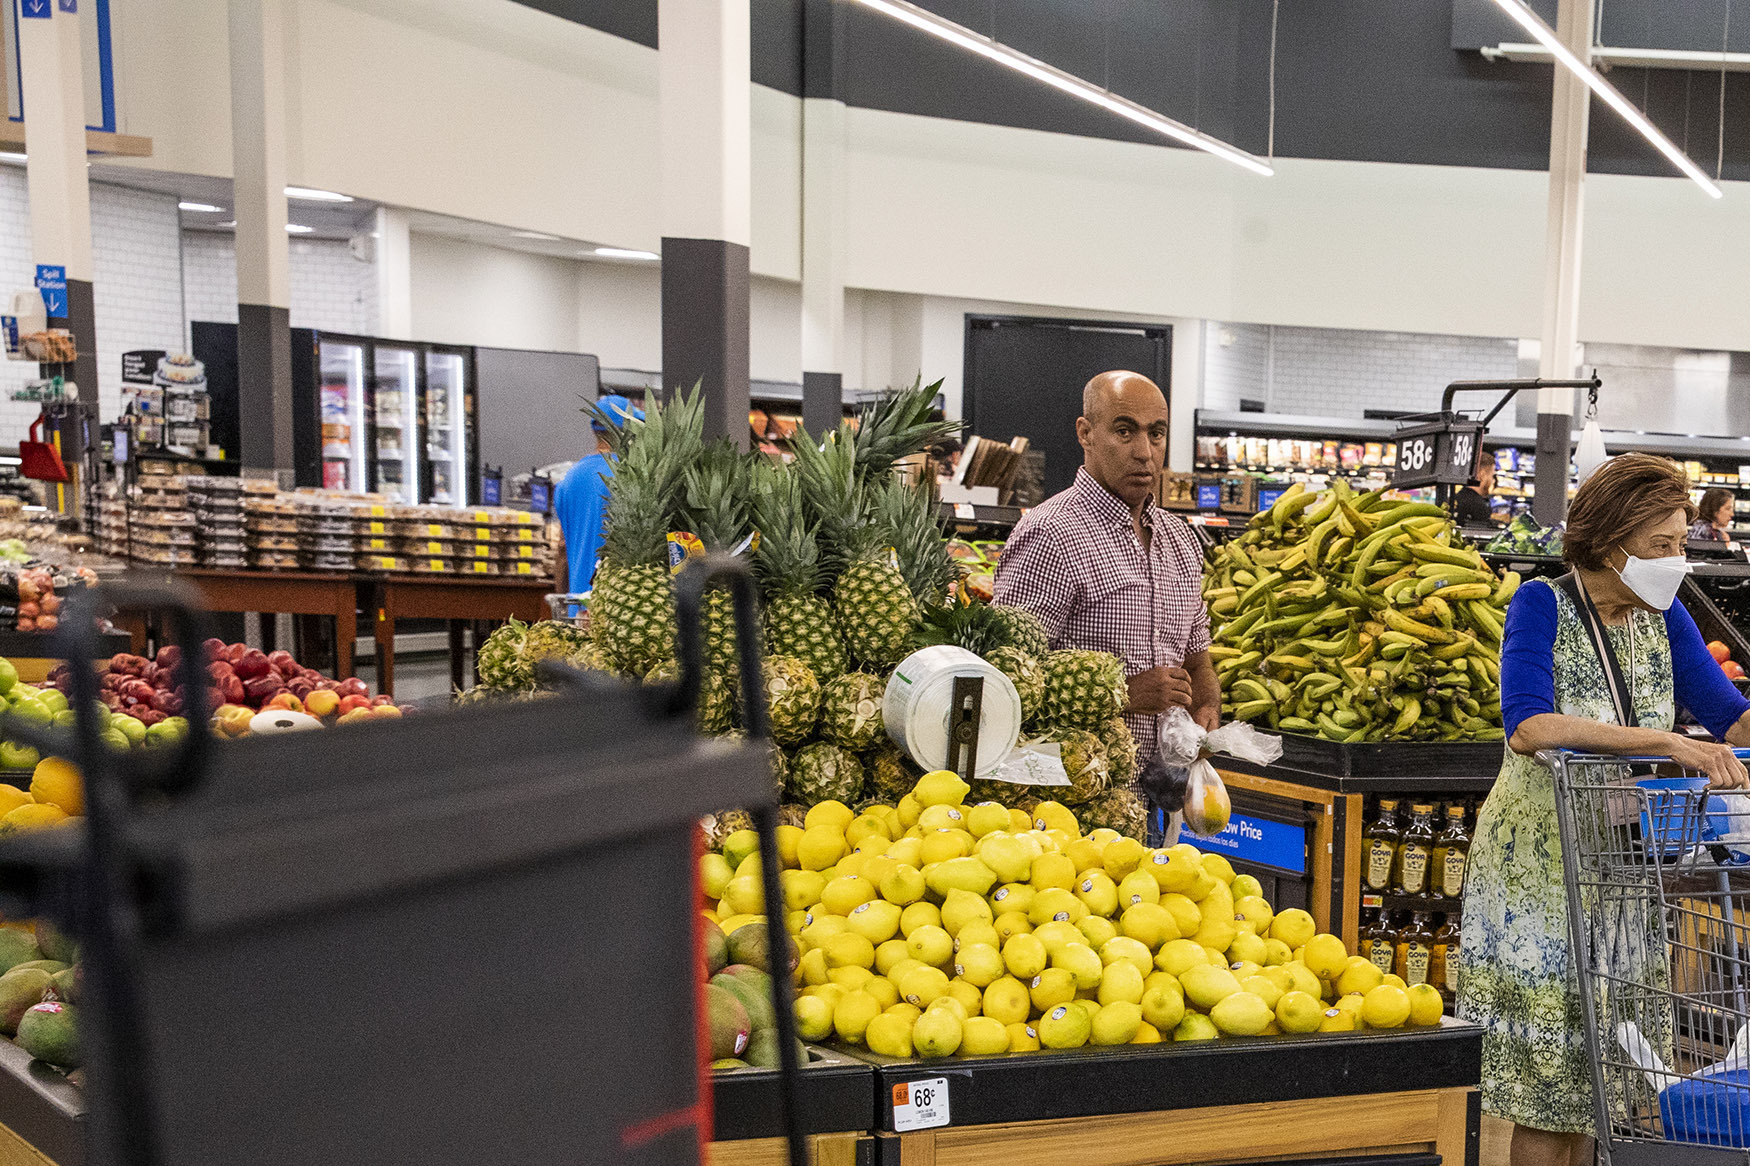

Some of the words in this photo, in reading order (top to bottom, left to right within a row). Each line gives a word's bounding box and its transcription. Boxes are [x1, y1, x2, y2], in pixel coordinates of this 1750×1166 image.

[1401, 439, 1433, 471] 58¢
[1240, 820, 1263, 840] Price
[1371, 849, 1392, 857] GOYA
[1371, 948, 1392, 956] GOYA
[1408, 951, 1428, 959] GOYA
[914, 1087, 936, 1108] 68¢
